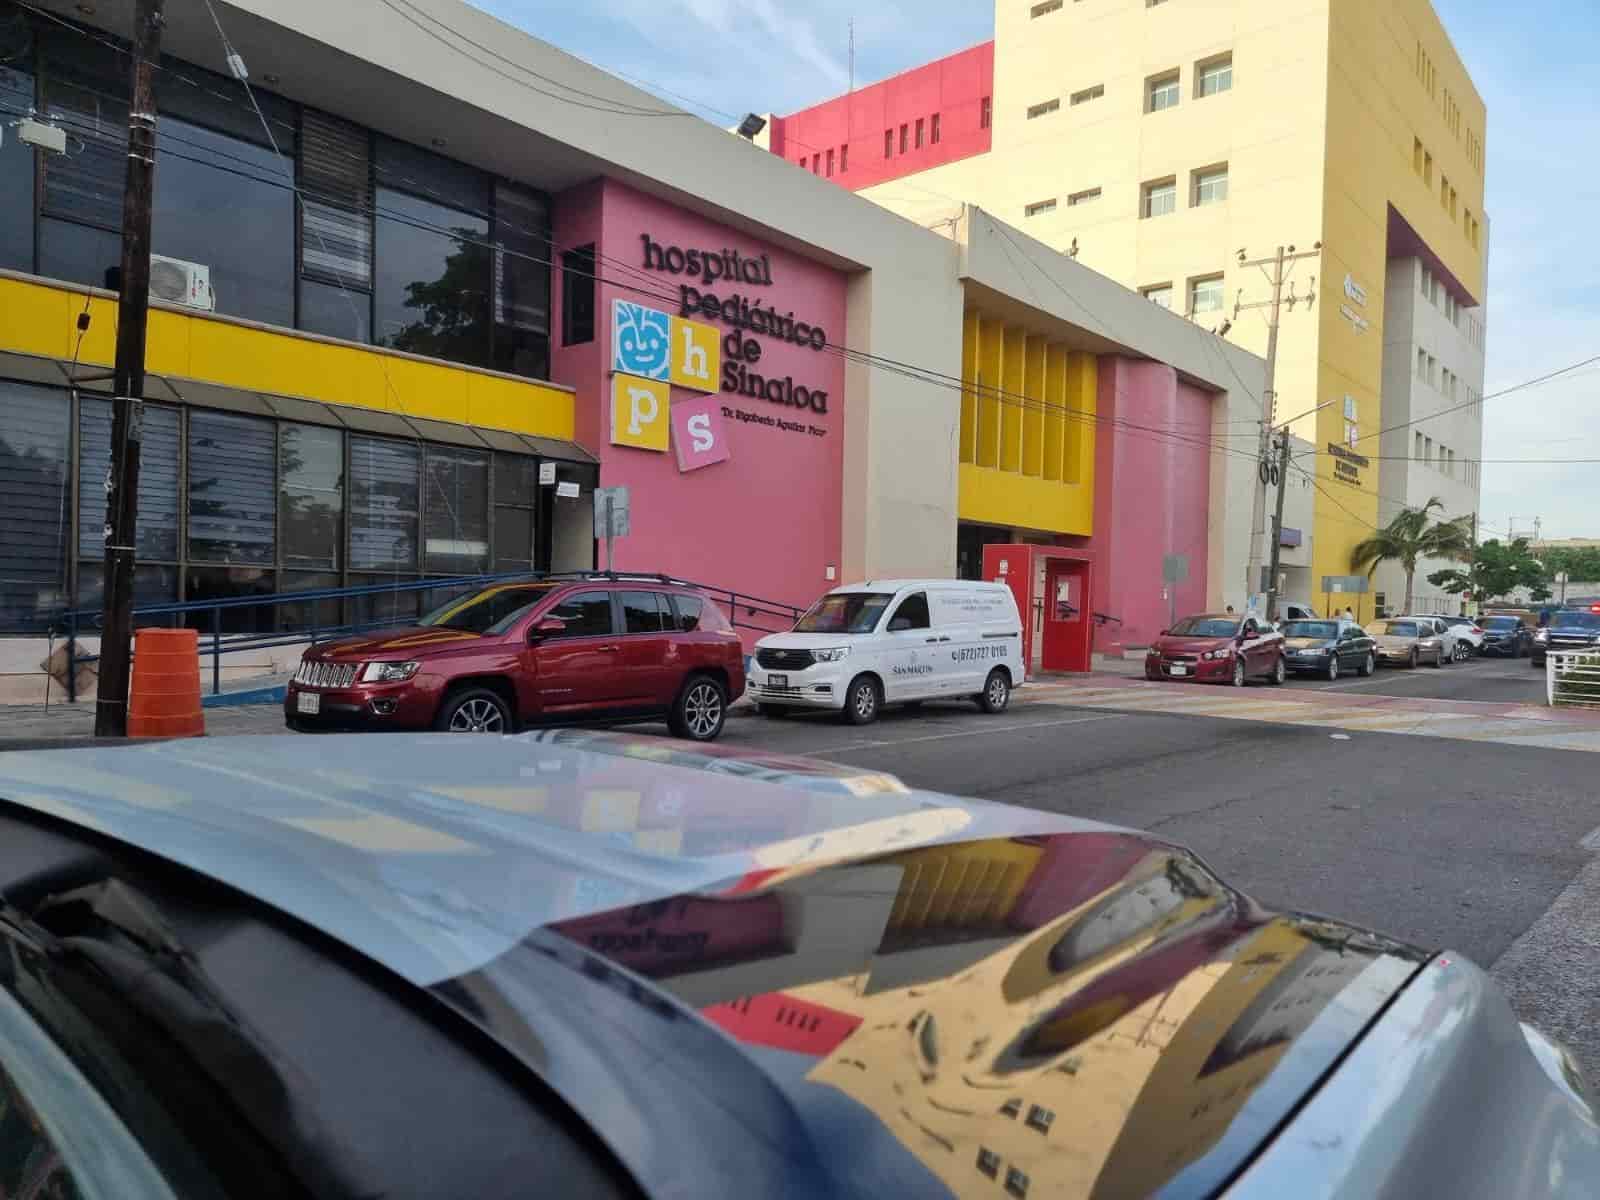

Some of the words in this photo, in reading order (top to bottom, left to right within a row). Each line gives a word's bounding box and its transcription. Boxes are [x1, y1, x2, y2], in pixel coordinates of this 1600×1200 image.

[641, 234, 772, 285] hospital
[679, 284, 827, 351] pediátrico
[682, 326, 709, 379] h
[723, 329, 762, 363] de
[722, 362, 828, 413] Sinaloa
[628, 387, 658, 435] p
[687, 413, 714, 453] s
